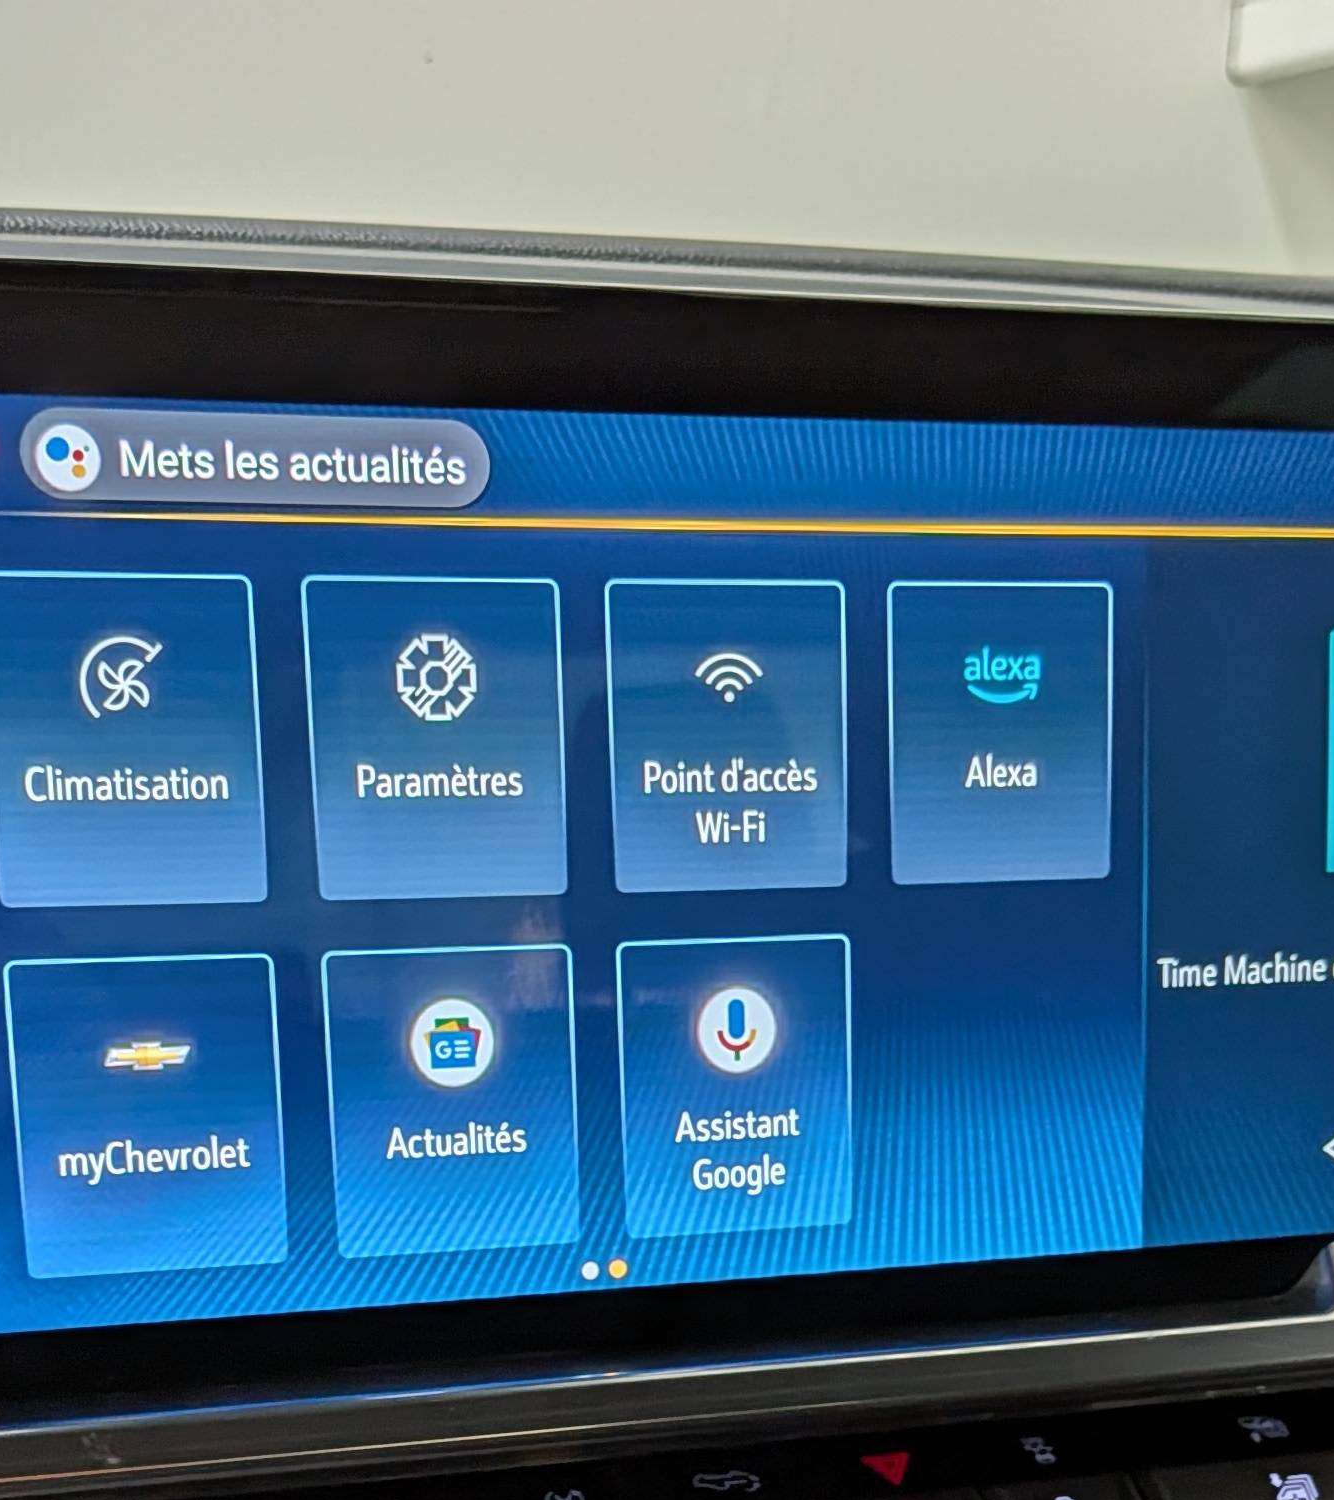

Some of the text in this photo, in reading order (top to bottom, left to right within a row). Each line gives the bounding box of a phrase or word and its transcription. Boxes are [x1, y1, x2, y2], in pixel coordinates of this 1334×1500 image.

[118, 438, 467, 486] Mets les actualités
[963, 645, 1042, 682] alexa
[24, 764, 229, 802] Climatisation
[356, 763, 524, 798] Paramètres
[643, 757, 818, 794] Point d'accès
[964, 752, 1038, 788] Alexa
[695, 809, 766, 844] Wi-Fi
[1156, 957, 1218, 989] Time
[1223, 951, 1328, 986] Machine
[386, 1121, 528, 1160] Actualités
[674, 1108, 800, 1143] Assistant
[57, 1134, 251, 1186] myChevrolet
[692, 1153, 786, 1196] Google
